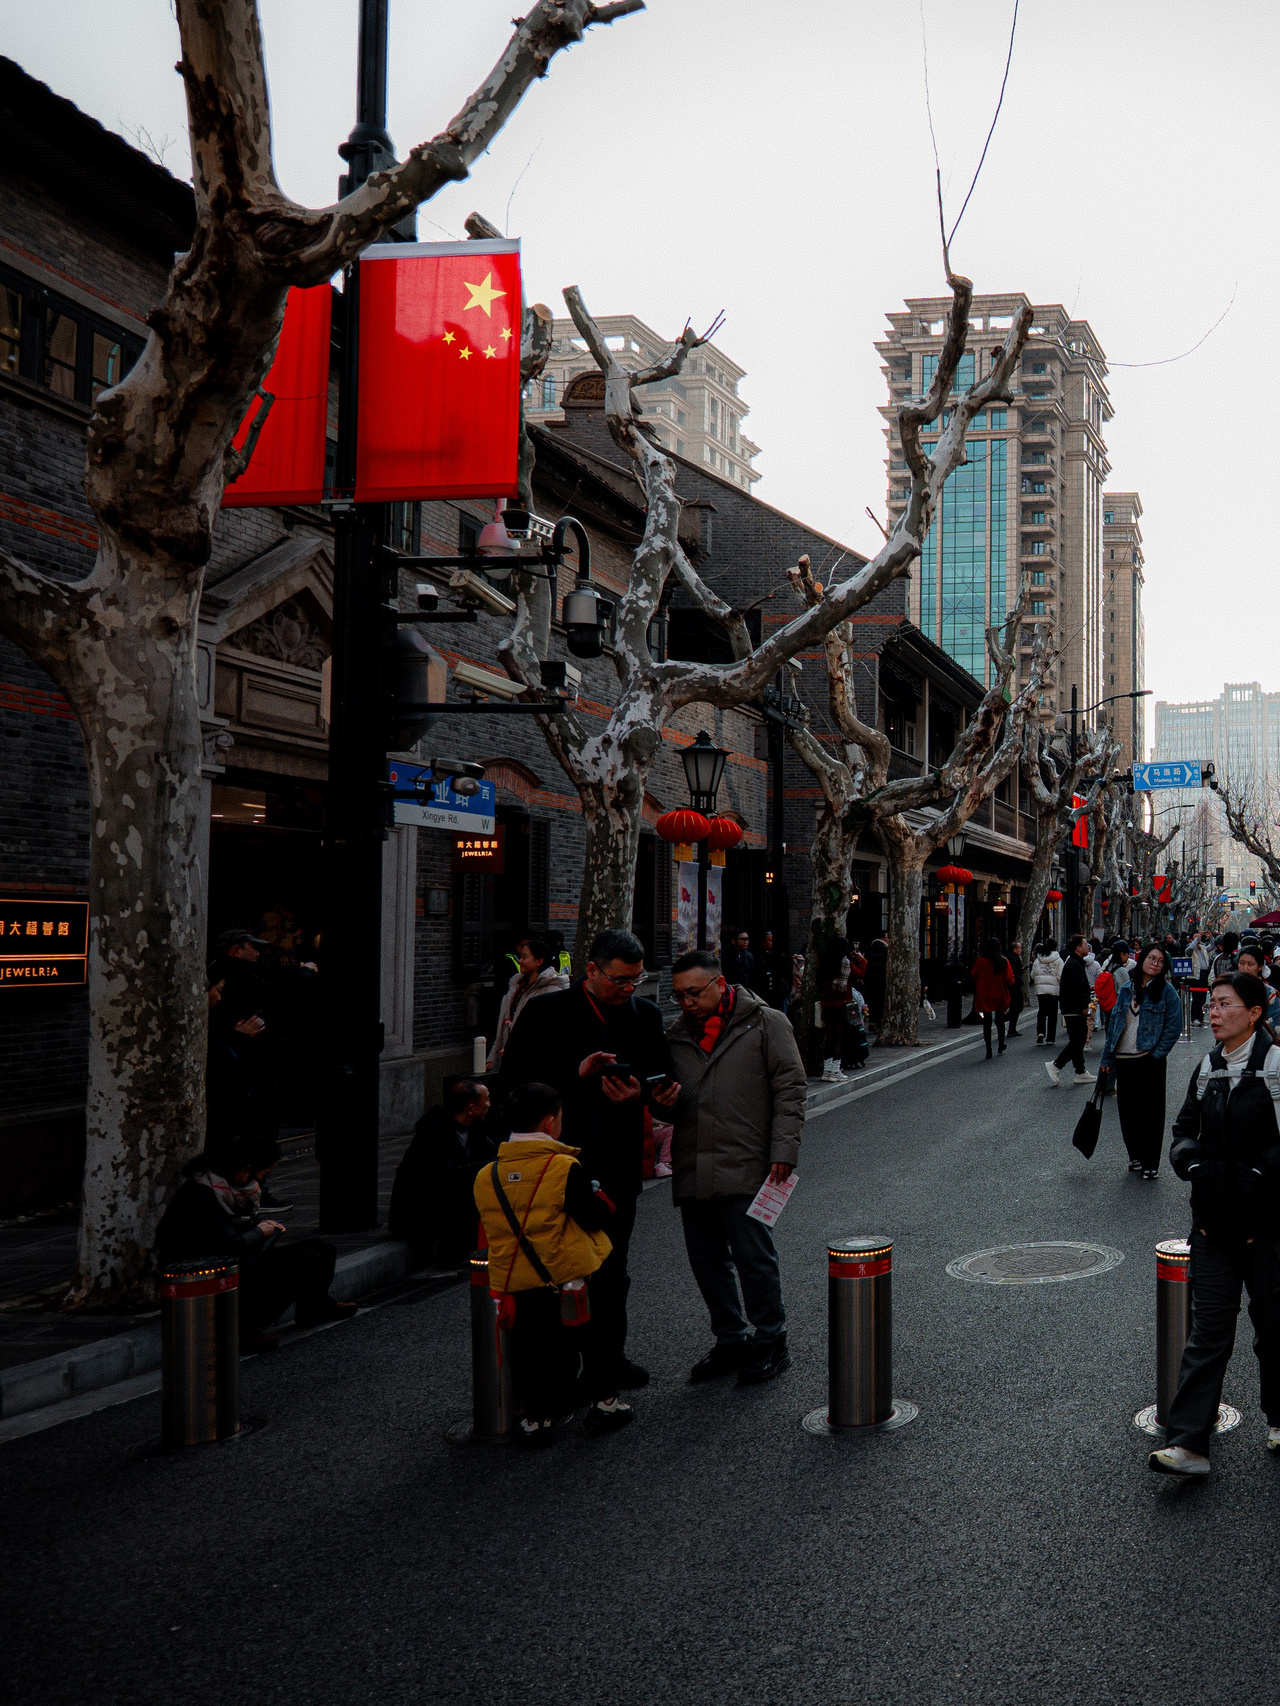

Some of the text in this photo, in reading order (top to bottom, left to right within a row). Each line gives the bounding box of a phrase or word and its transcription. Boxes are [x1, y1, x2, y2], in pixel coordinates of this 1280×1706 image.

[422, 811, 459, 824] Xingye Rd.
[481, 819, 490, 830] W
